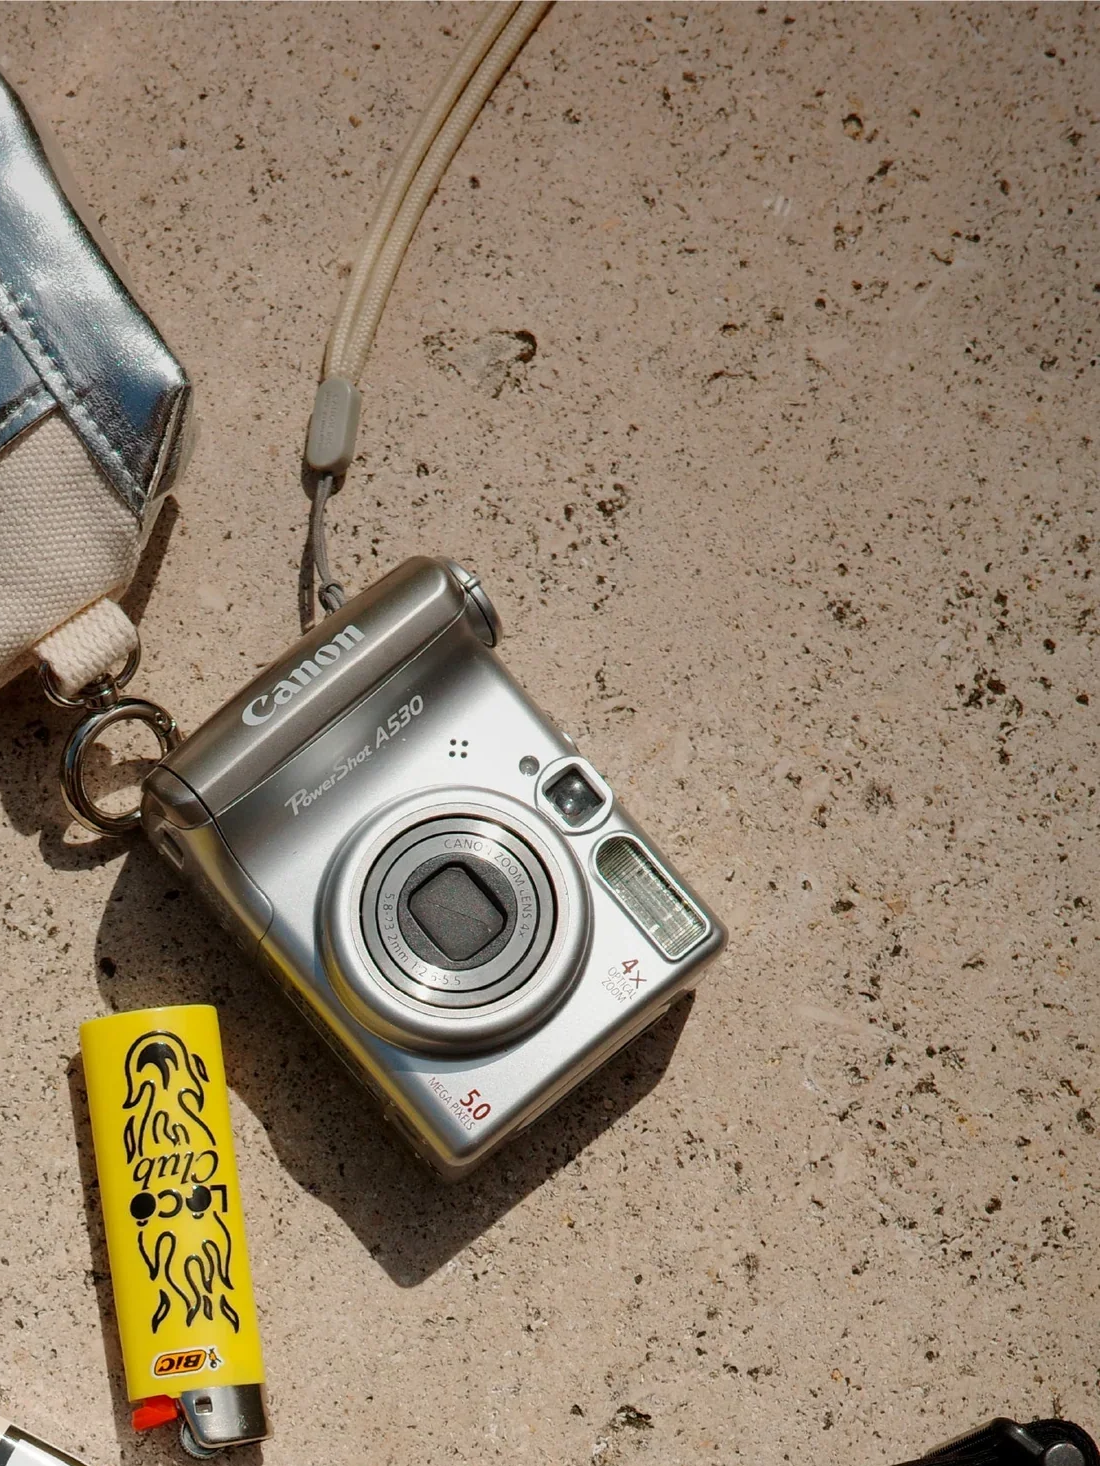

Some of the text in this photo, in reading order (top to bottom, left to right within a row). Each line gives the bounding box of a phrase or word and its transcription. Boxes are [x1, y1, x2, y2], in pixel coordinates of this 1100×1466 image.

[242, 624, 365, 726] Canon
[284, 695, 424, 815] PowerShot A530
[494, 850, 525, 887] ZOOM
[602, 977, 626, 1003] ZOOM
[608, 966, 636, 1000] OPTICAL
[428, 1077, 475, 1130] MEGA PIXELS
[460, 1089, 491, 1120] 5.0
[132, 1150, 218, 1190] Club
